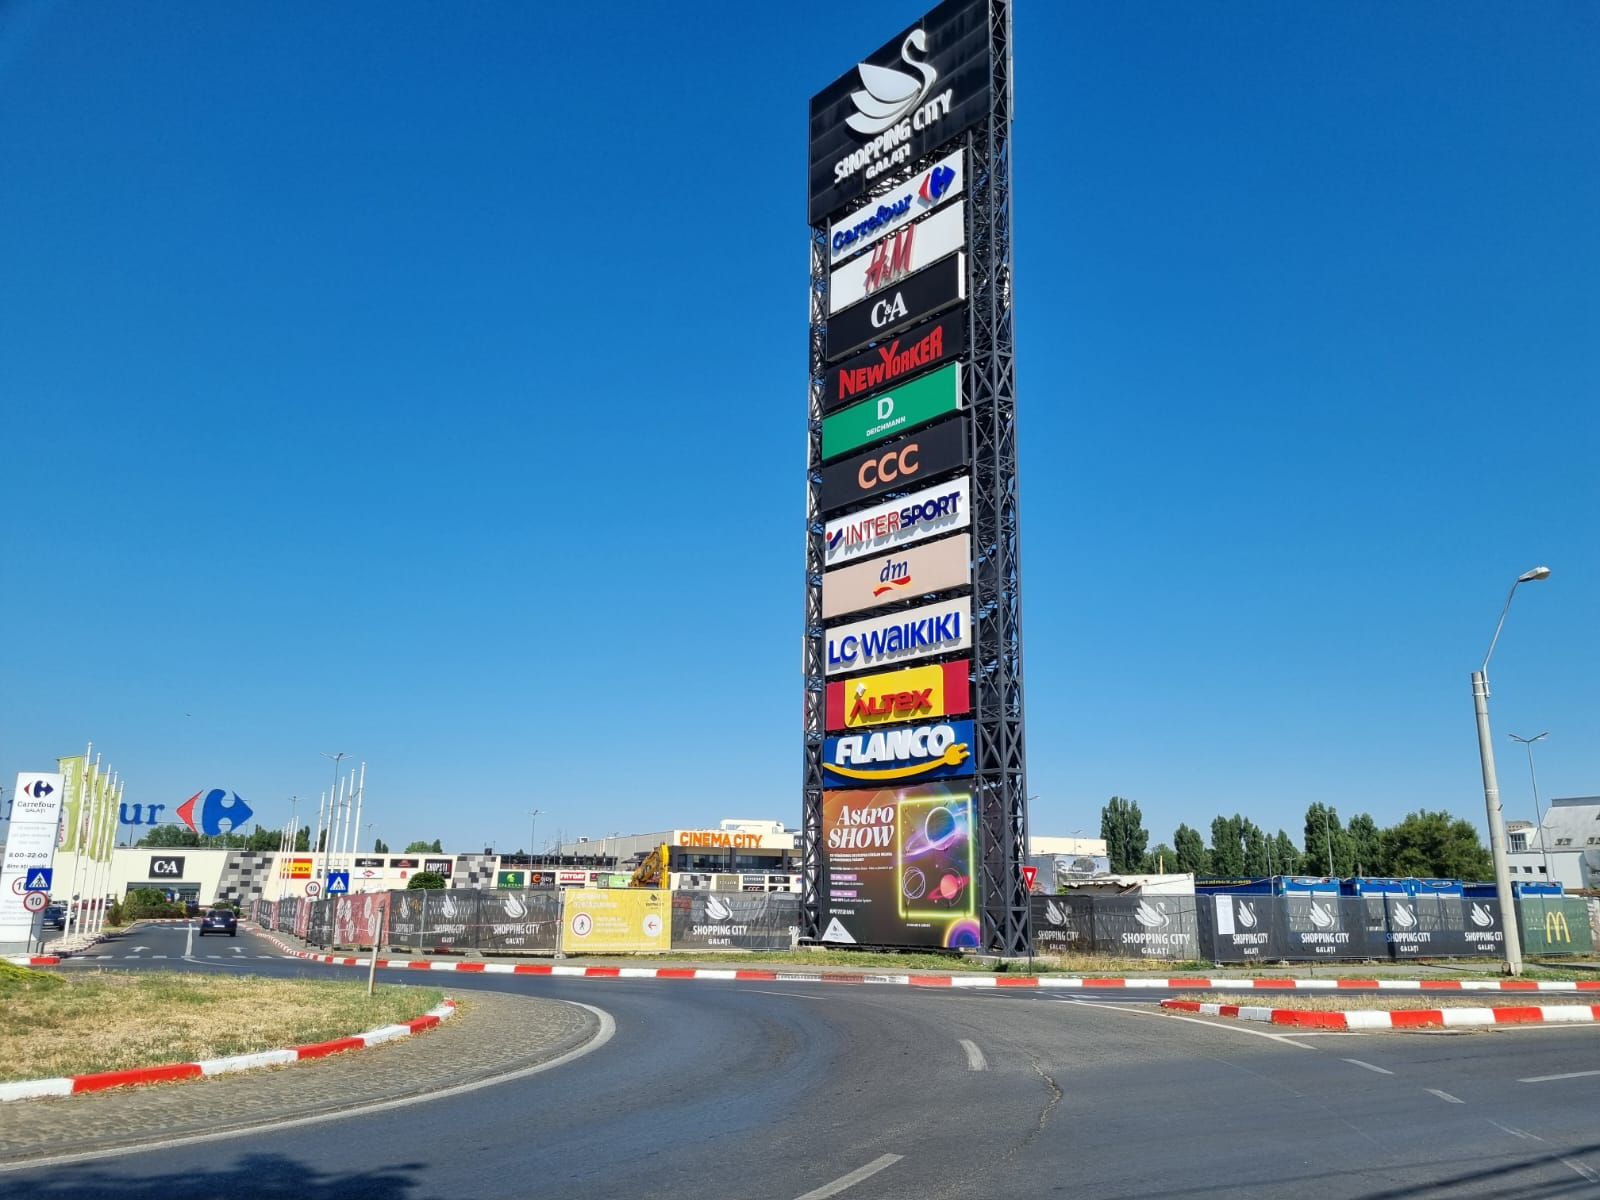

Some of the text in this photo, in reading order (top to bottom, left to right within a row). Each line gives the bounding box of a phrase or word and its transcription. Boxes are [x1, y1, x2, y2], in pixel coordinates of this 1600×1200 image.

[834, 89, 952, 184] SHOPPING CITY
[832, 194, 912, 250] Carrefour
[865, 223, 916, 290] H&M
[871, 291, 908, 328] C&A
[866, 415, 906, 437] DEICHMANN
[858, 443, 919, 489] CCC
[845, 491, 961, 545] INTERSPORT
[880, 560, 908, 583] dm
[828, 635, 858, 665] LC
[835, 724, 955, 765] FLANCO
[837, 805, 894, 827] Astro
[680, 832, 763, 848] CINEMA CITY
[828, 827, 895, 850] SHOW
[29, 897, 42, 906] 10
[493, 924, 540, 935] SHOPPING CITY
[692, 925, 748, 935] SHOPPING CITY
[1038, 930, 1066, 941] SHOPPING
[1122, 932, 1190, 945] SHOPPING CITY
[1301, 932, 1349, 943] SHOPPING CITY
[1386, 932, 1430, 943] SHOPPING CITY
[1464, 931, 1494, 942] SHOPPING
